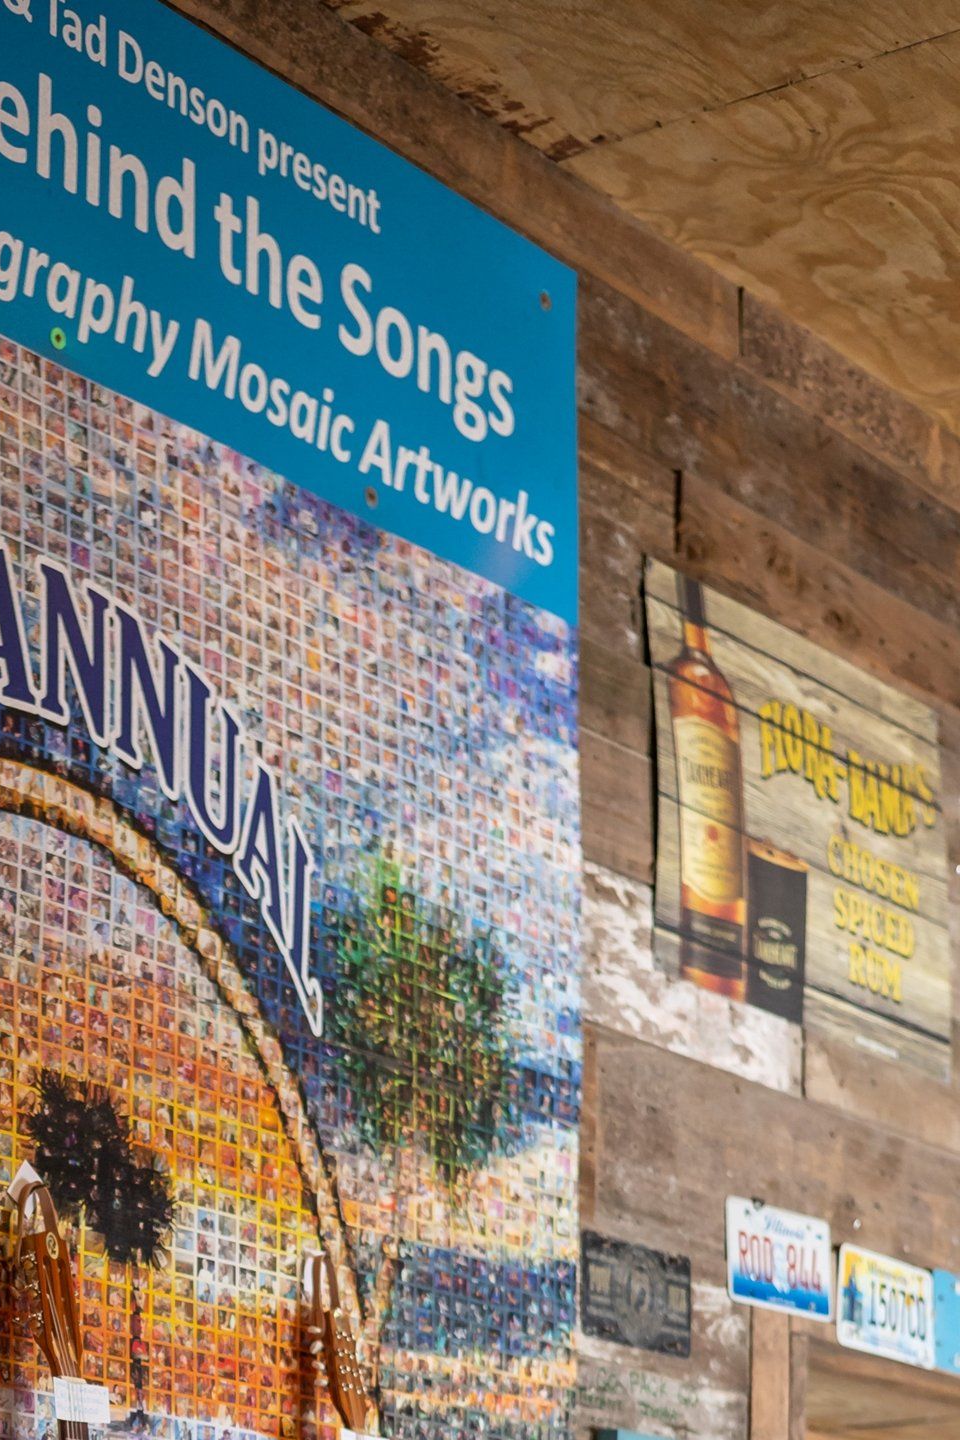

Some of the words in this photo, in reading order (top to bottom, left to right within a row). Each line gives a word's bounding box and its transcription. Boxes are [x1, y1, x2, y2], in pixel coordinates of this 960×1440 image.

[48, 0, 106, 67] Tad
[118, 30, 250, 152] Denson
[258, 126, 381, 234] present
[214, 192, 322, 329] the
[338, 262, 516, 442] Songs
[188, 319, 352, 463] Mosaic
[358, 419, 555, 567] Artworks
[827, 834, 919, 911] CHOSEN
[833, 887, 915, 959] SPICED
[848, 941, 903, 1003] RUM
[787, 1244, 822, 1291] 844
